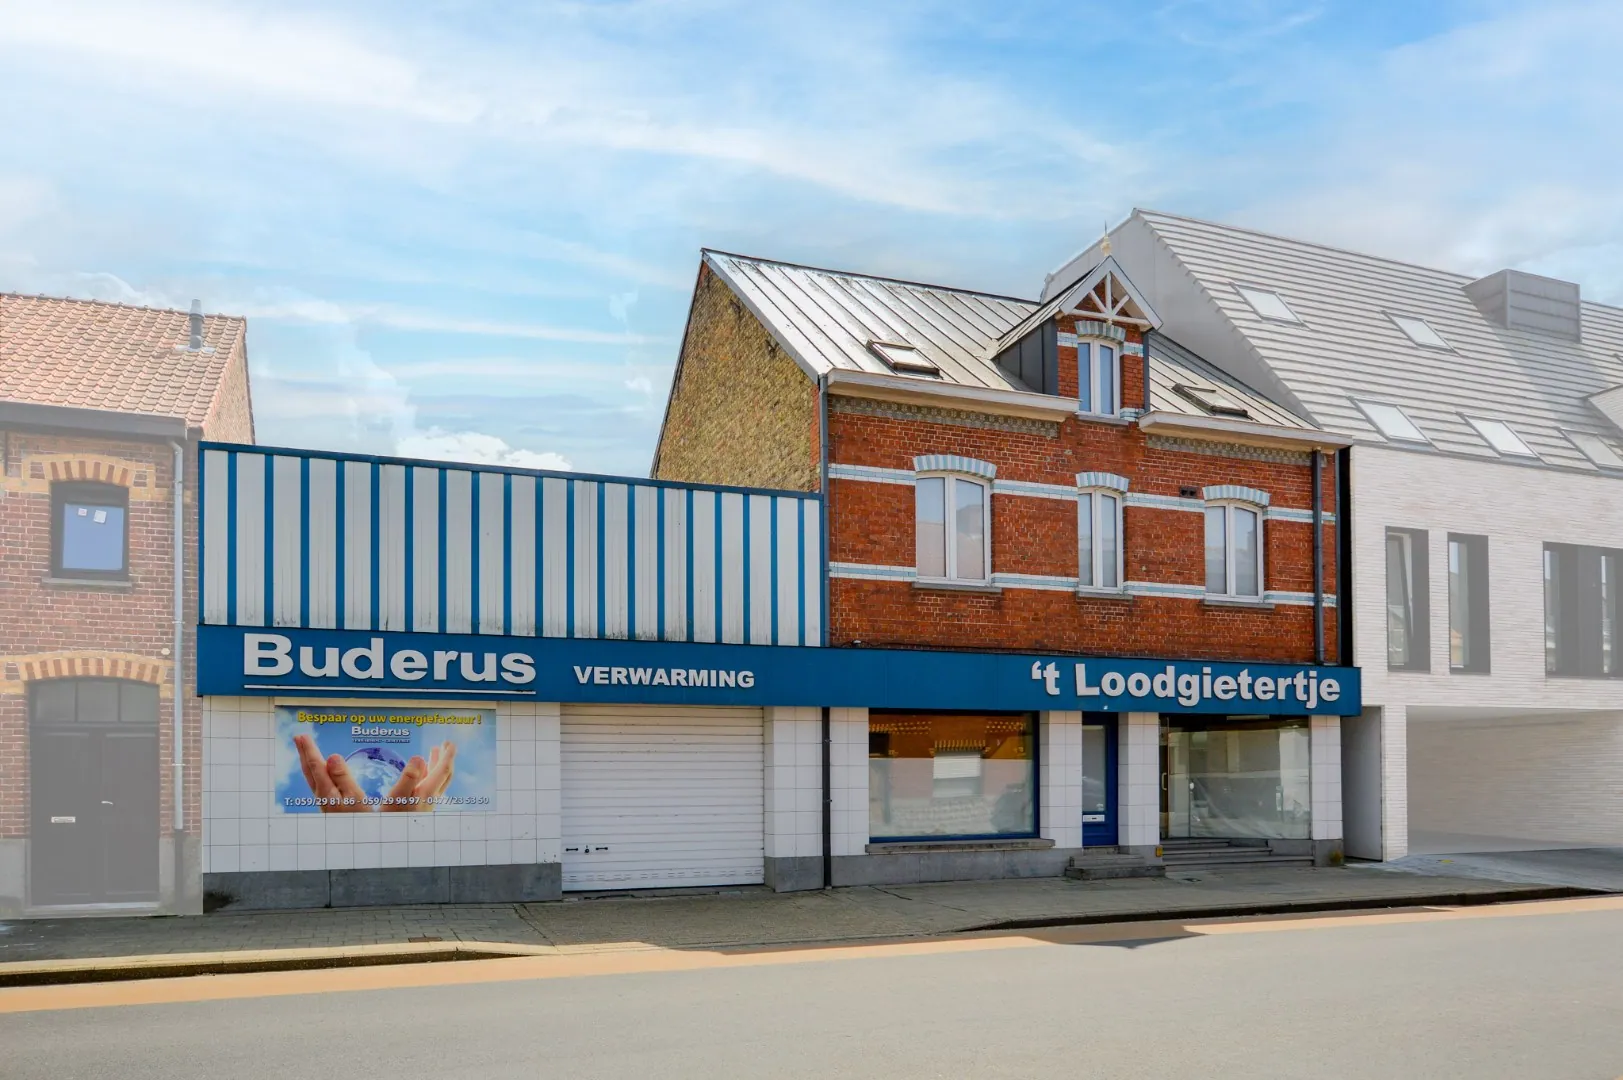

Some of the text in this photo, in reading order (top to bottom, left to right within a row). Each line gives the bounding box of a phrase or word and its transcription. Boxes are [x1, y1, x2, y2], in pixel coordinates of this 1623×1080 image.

[243, 632, 537, 685] Buderus
[573, 665, 755, 688] VERWARMING
[1075, 662, 1341, 709] Loodgietertje
[297, 711, 347, 725] Bespaar
[350, 714, 366, 725] op
[368, 715, 386, 723] uw
[351, 726, 410, 736] Buderus
[285, 797, 293, 806] T:
[295, 797, 328, 806] 059/29
[330, 797, 340, 806] 81
[343, 797, 355, 806] 86
[362, 796, 394, 806] 059/29
[396, 796, 407, 805] 96
[409, 796, 420, 805] 97
